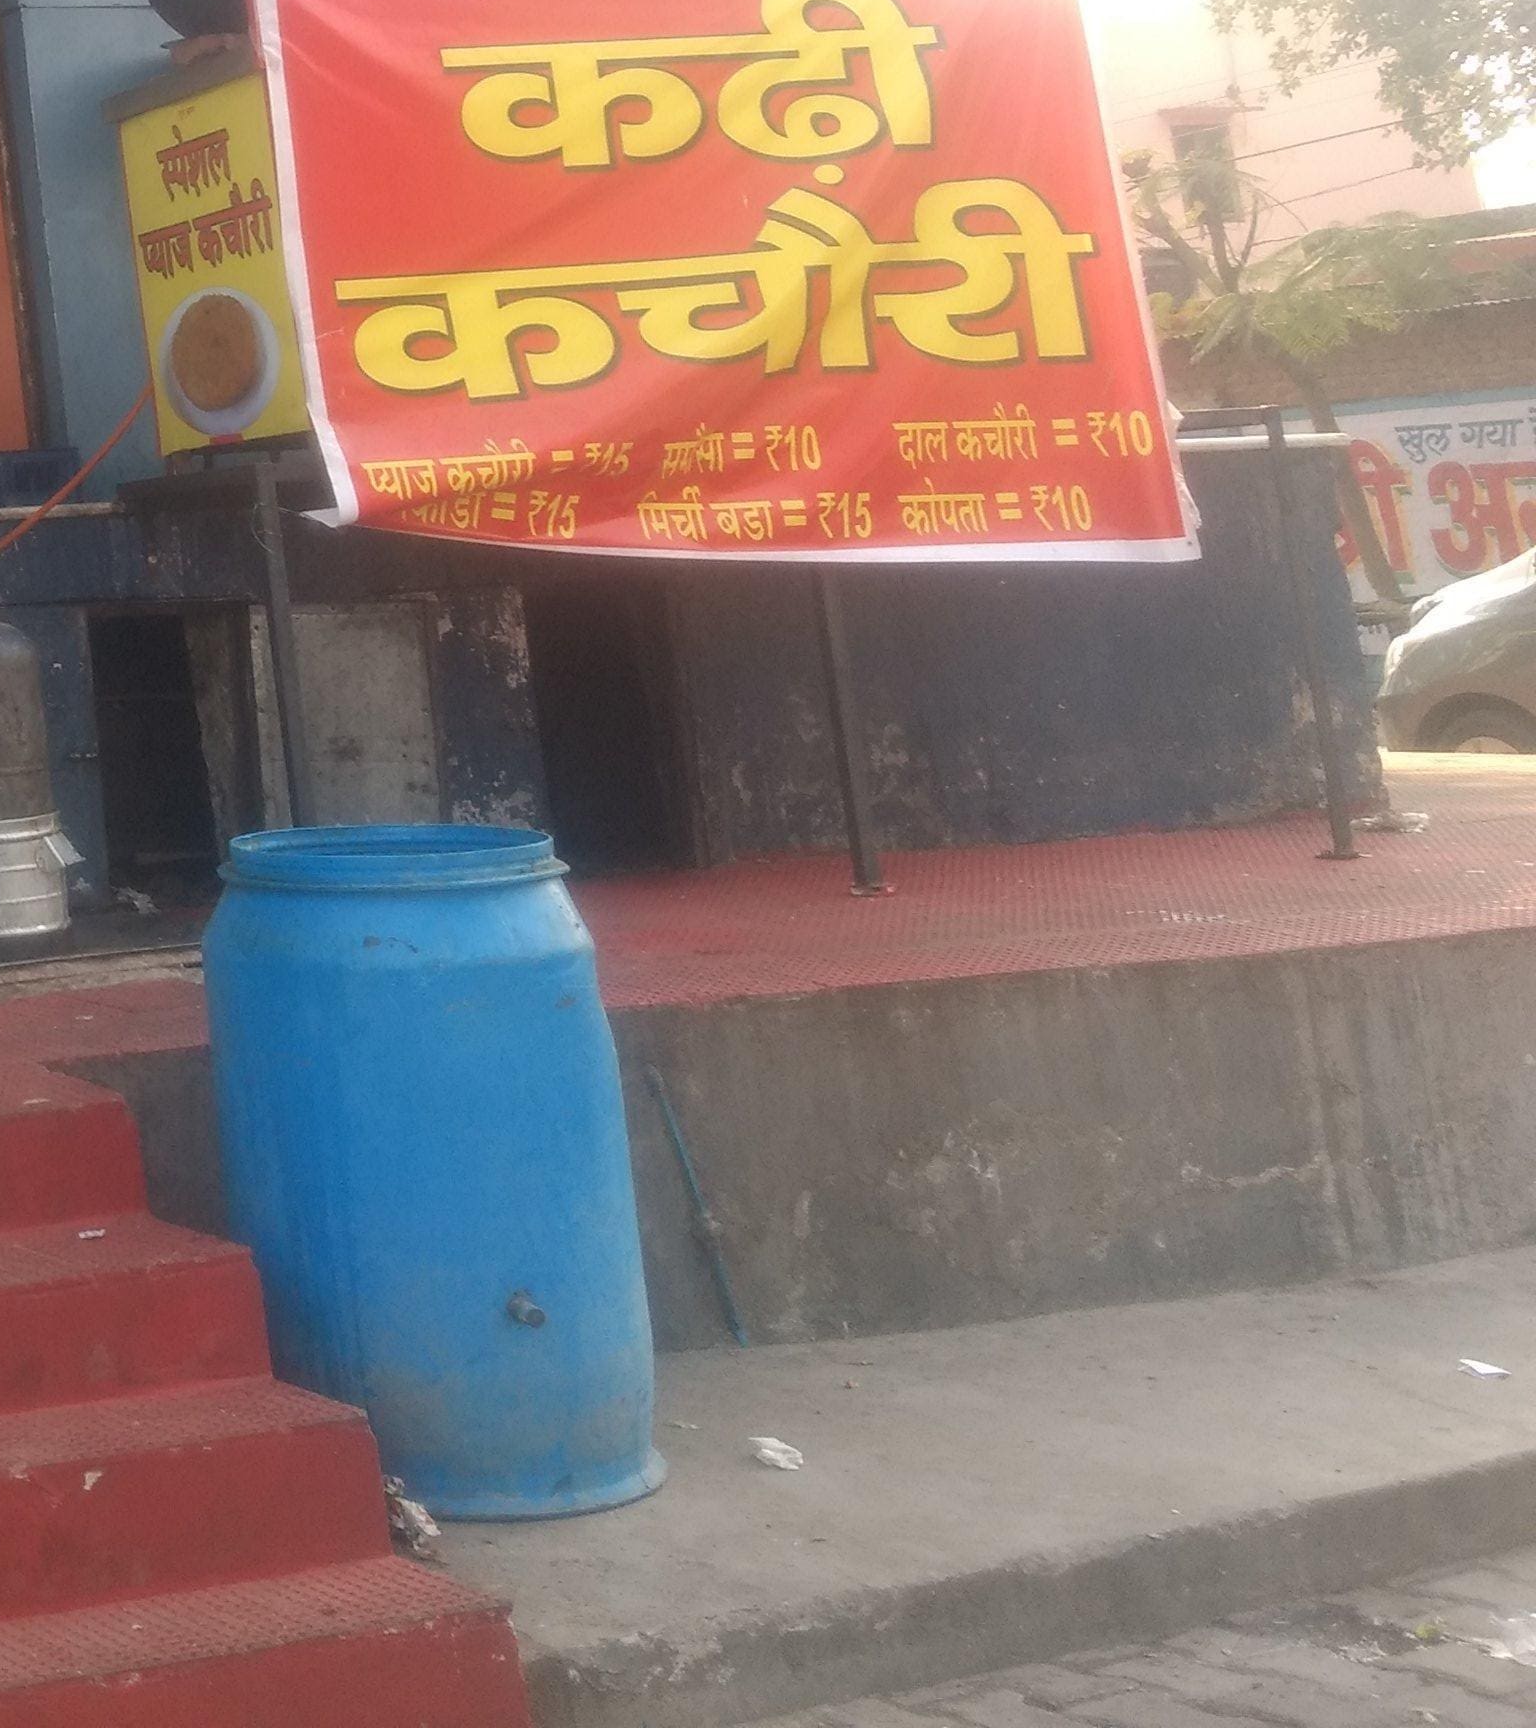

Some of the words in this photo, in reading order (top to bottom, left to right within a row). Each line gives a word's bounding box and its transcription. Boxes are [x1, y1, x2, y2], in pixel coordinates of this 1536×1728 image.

[137, 220, 195, 281] प्याज
[194, 177, 274, 268] कचौरी
[334, 177, 1095, 401] कचौरी
[730, 431, 756, 461] =
[763, 424, 822, 472] ₹10
[891, 420, 948, 470] दाल
[952, 402, 1039, 462] कचौरी
[1051, 417, 1079, 447] =
[1085, 410, 1154, 458] ₹10
[1459, 418, 1525, 450] गया
[359, 458, 438, 501] प्याज
[896, 476, 989, 535] कोपता
[994, 491, 1023, 521] =
[1030, 484, 1094, 534] ₹10
[528, 489, 581, 540] ₹15
[636, 484, 709, 542] मिर्ची
[708, 500, 774, 542] बडा
[779, 498, 808, 528] =
[816, 491, 874, 540] ₹15
